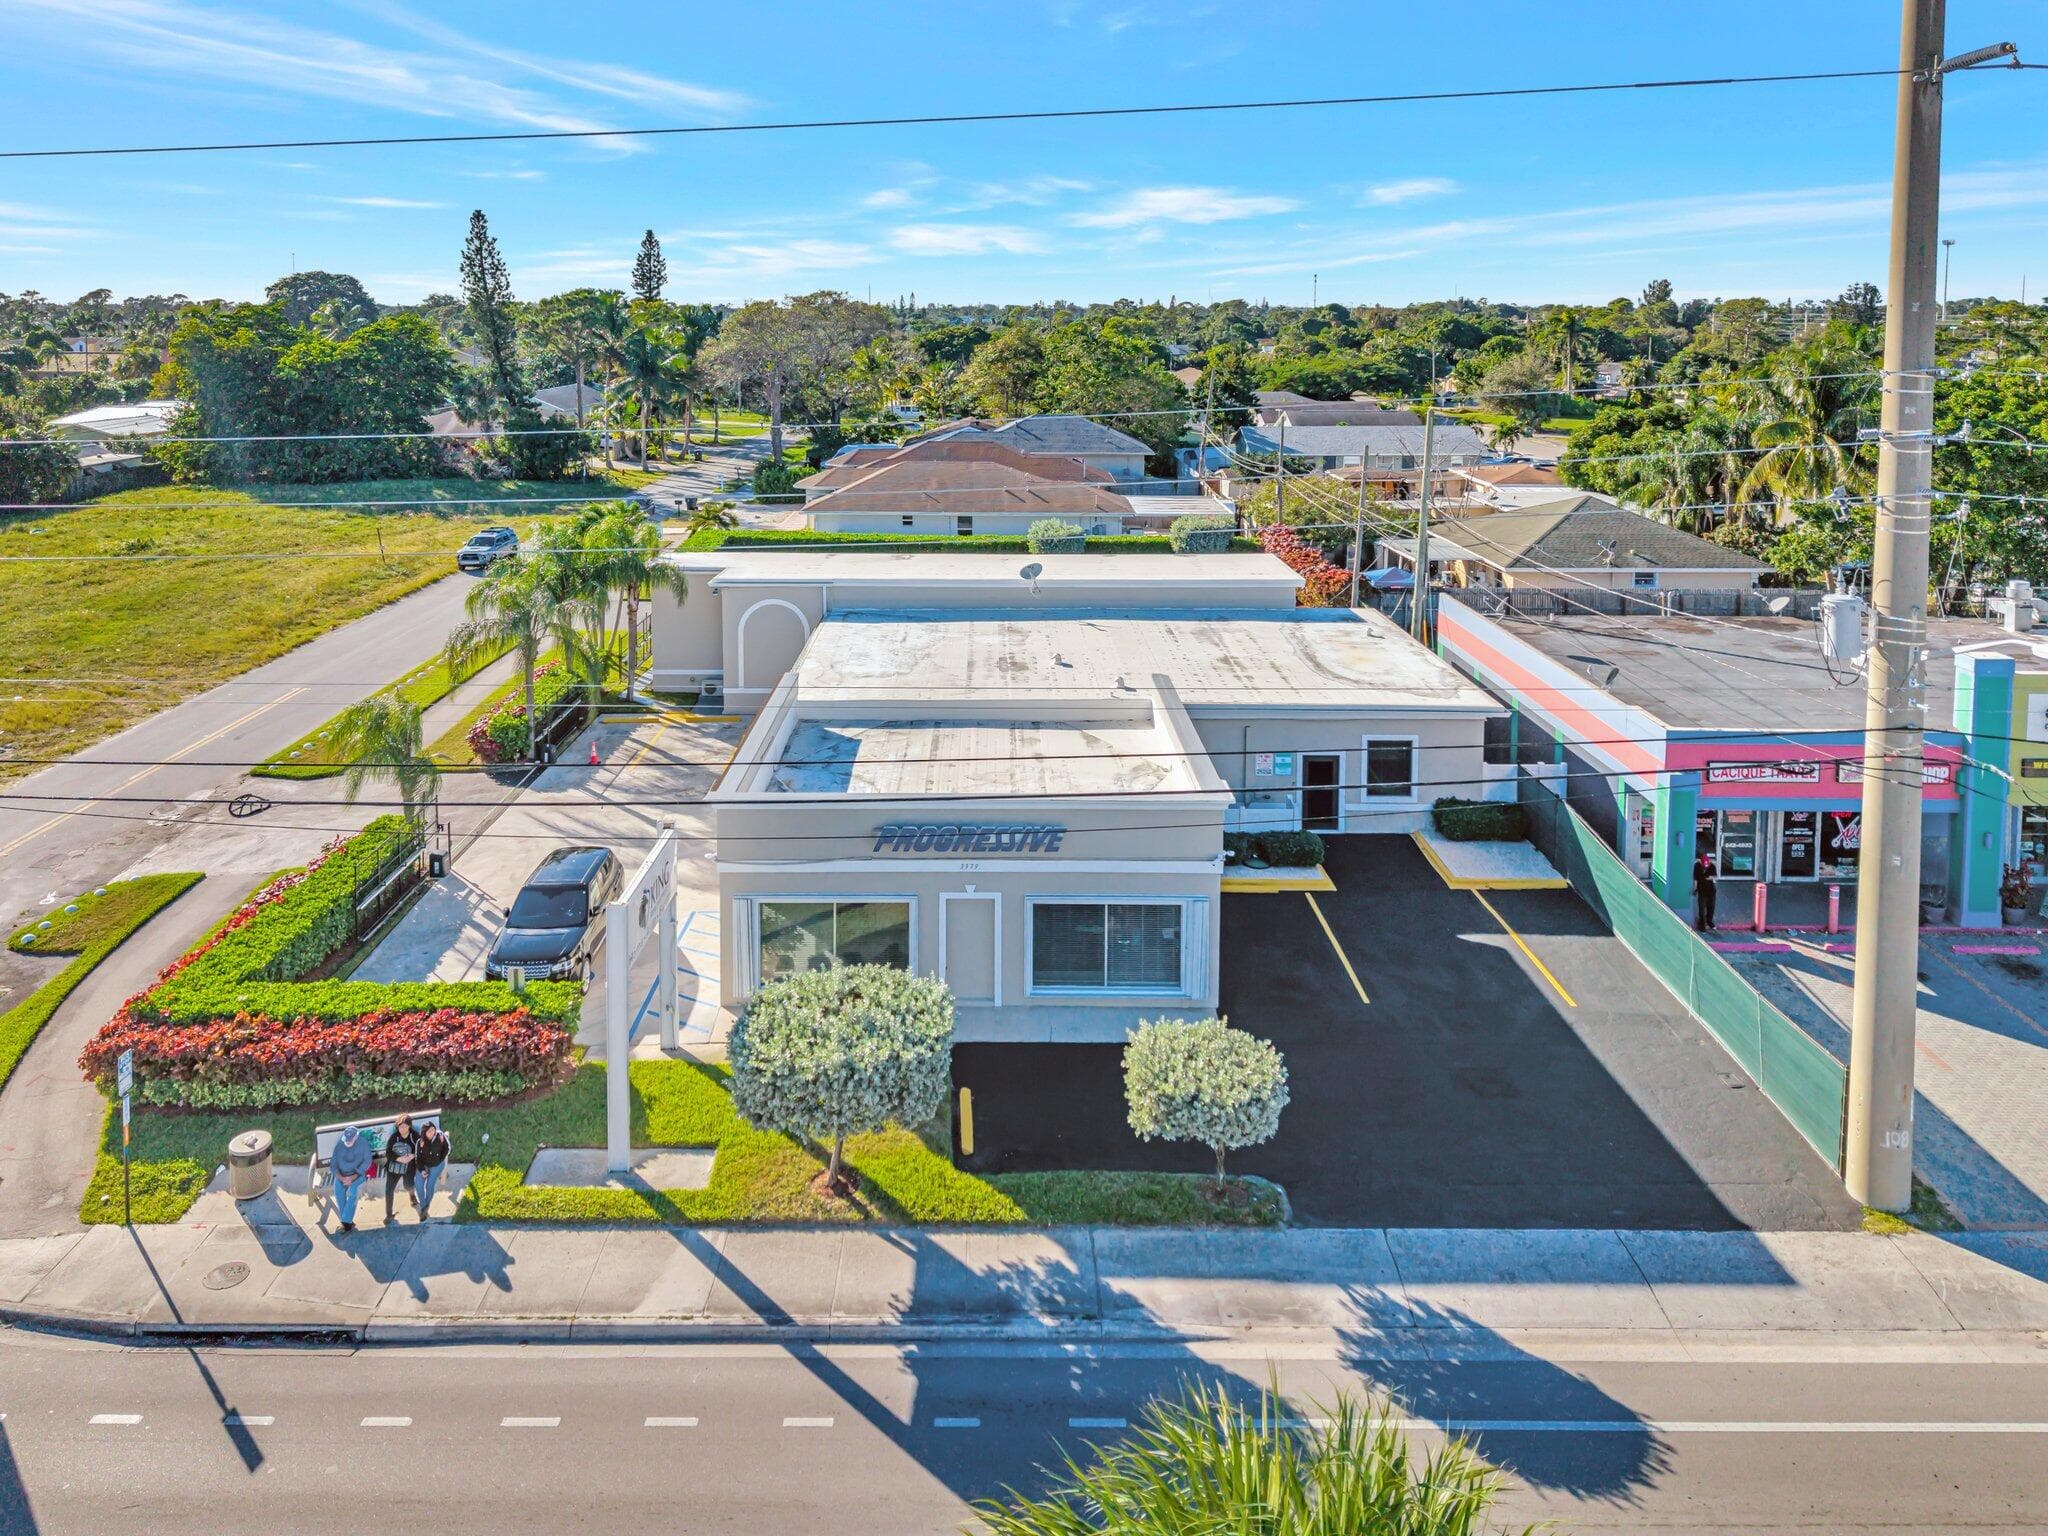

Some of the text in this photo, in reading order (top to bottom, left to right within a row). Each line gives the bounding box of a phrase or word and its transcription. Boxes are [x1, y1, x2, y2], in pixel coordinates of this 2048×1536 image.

[1712, 767, 1766, 778] CACIQUE
[1921, 766, 1949, 783] HOP
[873, 826, 1067, 852] PROGRESSIVE
